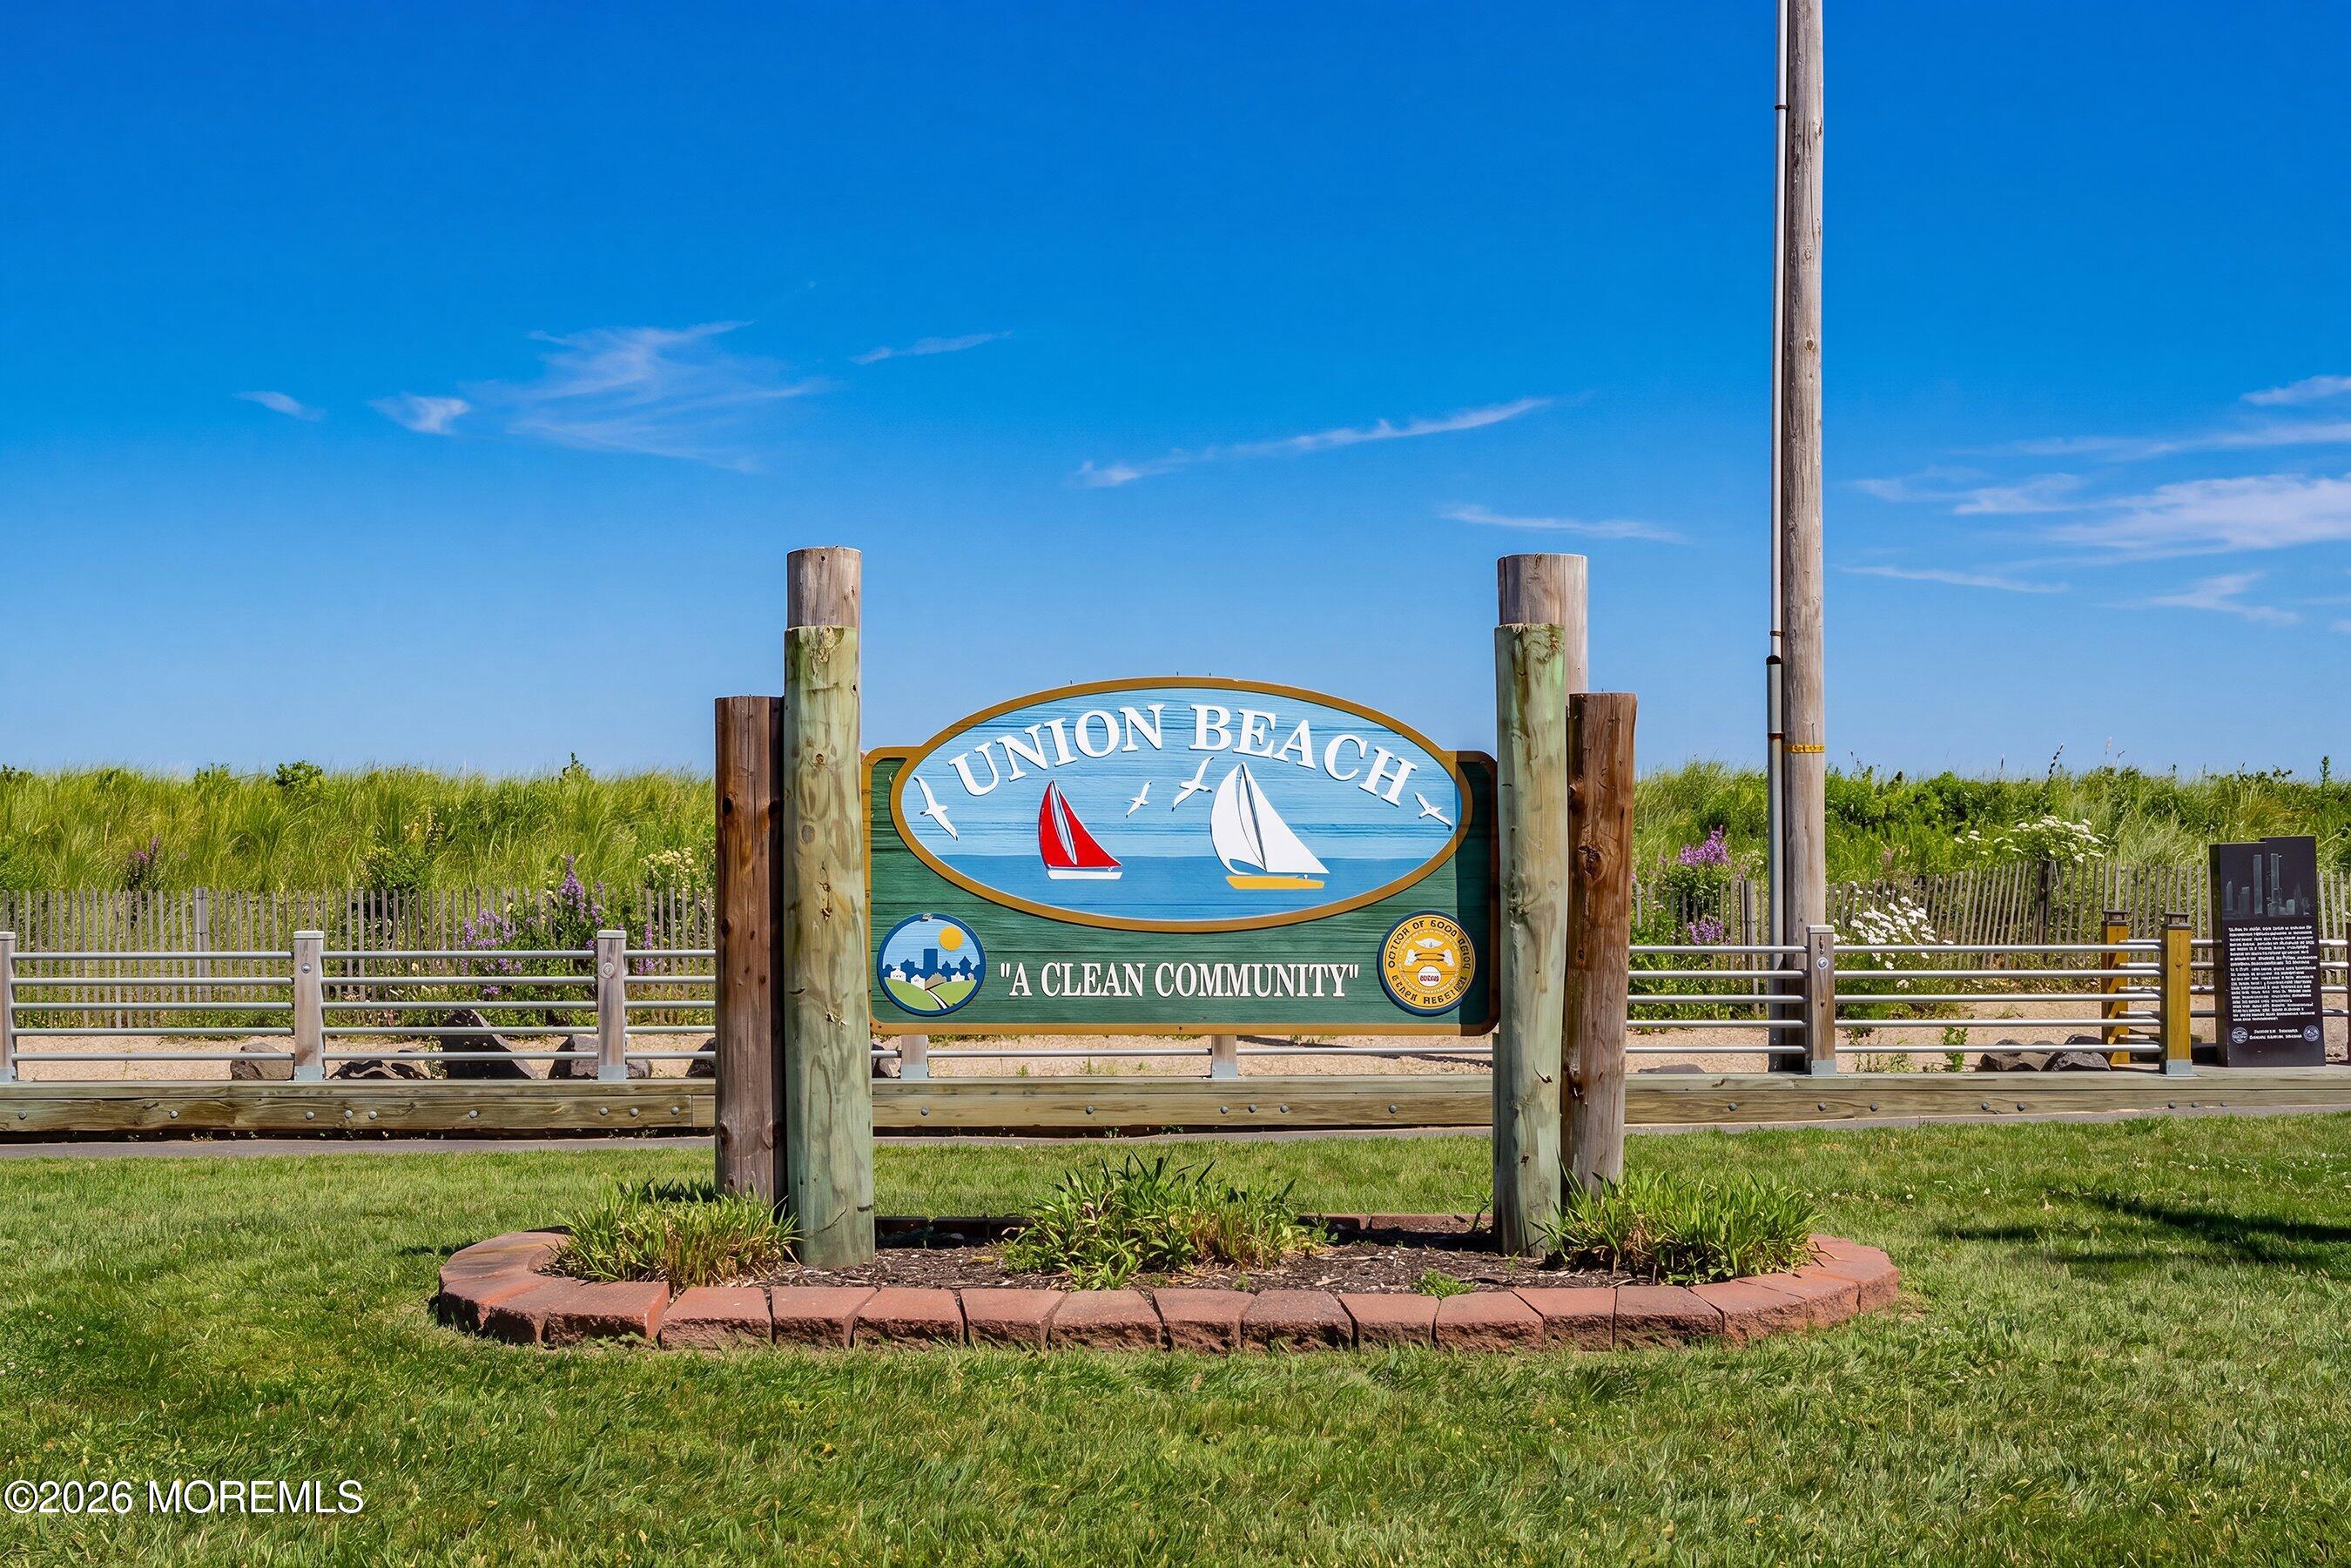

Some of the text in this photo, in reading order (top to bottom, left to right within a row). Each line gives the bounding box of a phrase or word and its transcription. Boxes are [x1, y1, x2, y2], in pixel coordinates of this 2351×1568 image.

[947, 703, 1418, 807] UNION BEACH
[999, 962, 1033, 997] "A
[1041, 961, 1146, 998] CLEAN
[1155, 961, 1359, 999] COMMUNITY"
